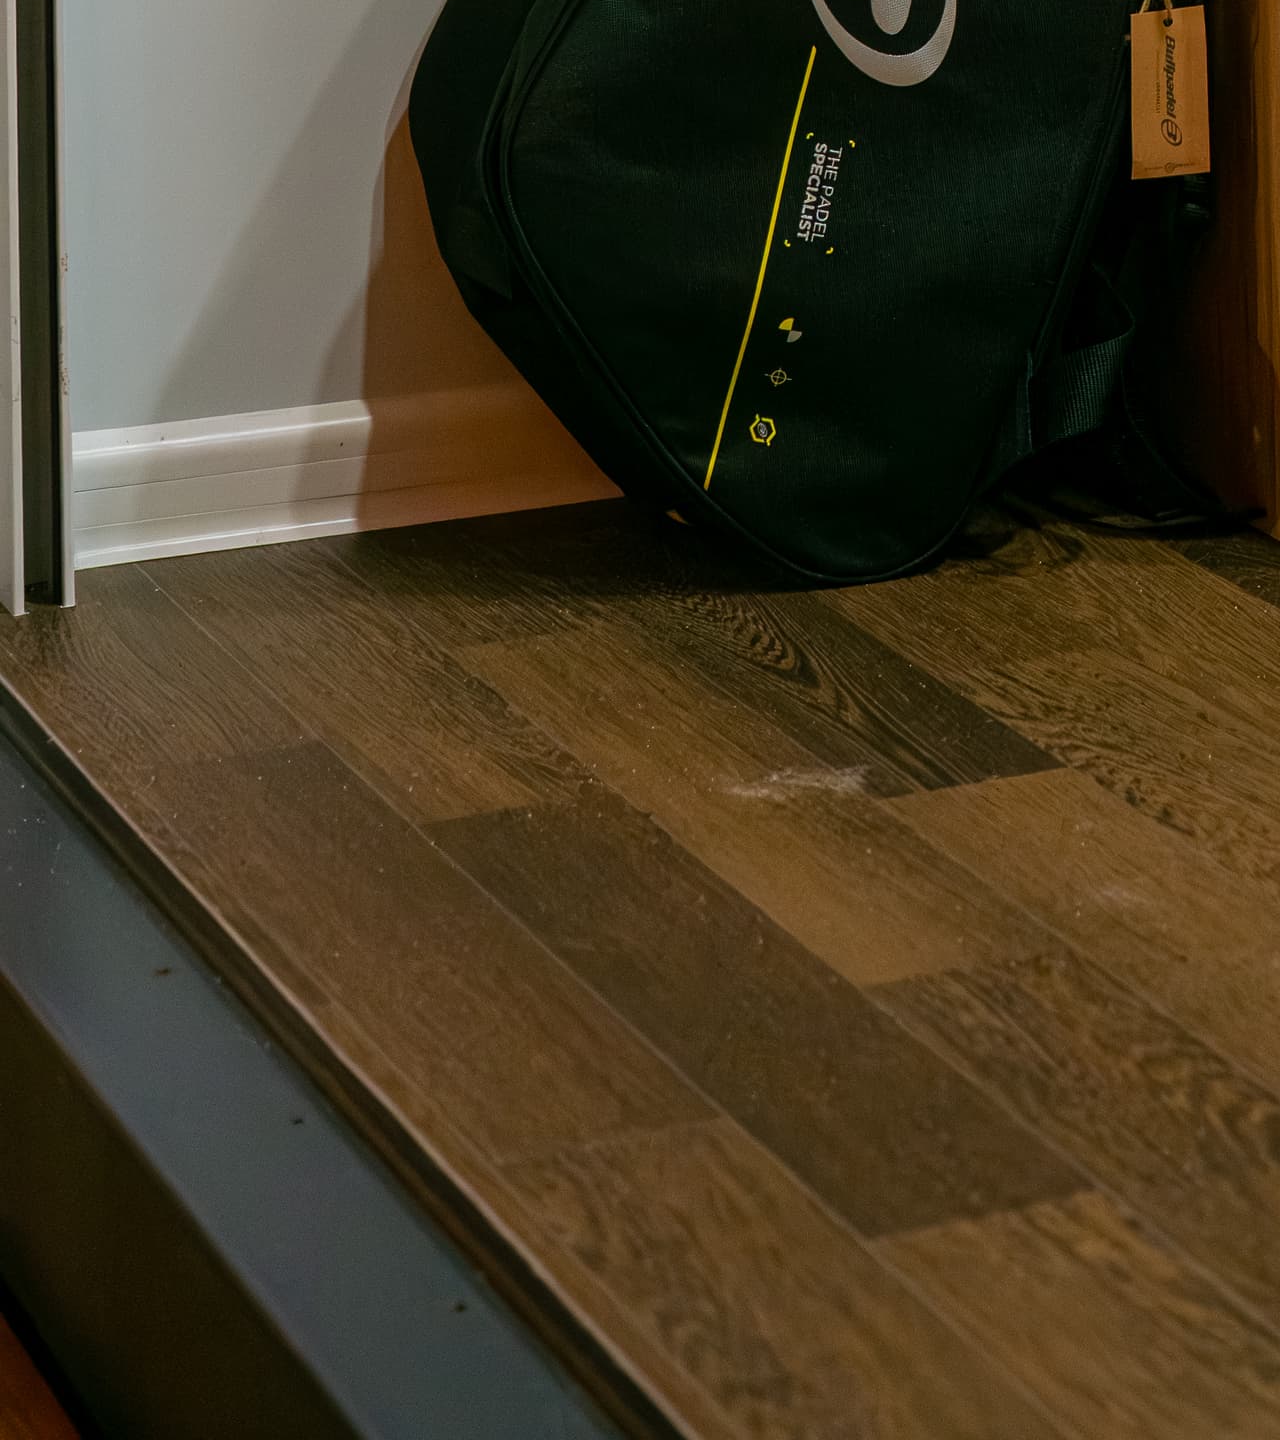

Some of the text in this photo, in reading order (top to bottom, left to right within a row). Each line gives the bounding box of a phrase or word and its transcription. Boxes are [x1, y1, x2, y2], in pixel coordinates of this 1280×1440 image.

[796, 141, 829, 243] SPECIALIST
[810, 146, 844, 243] THE PADEL
